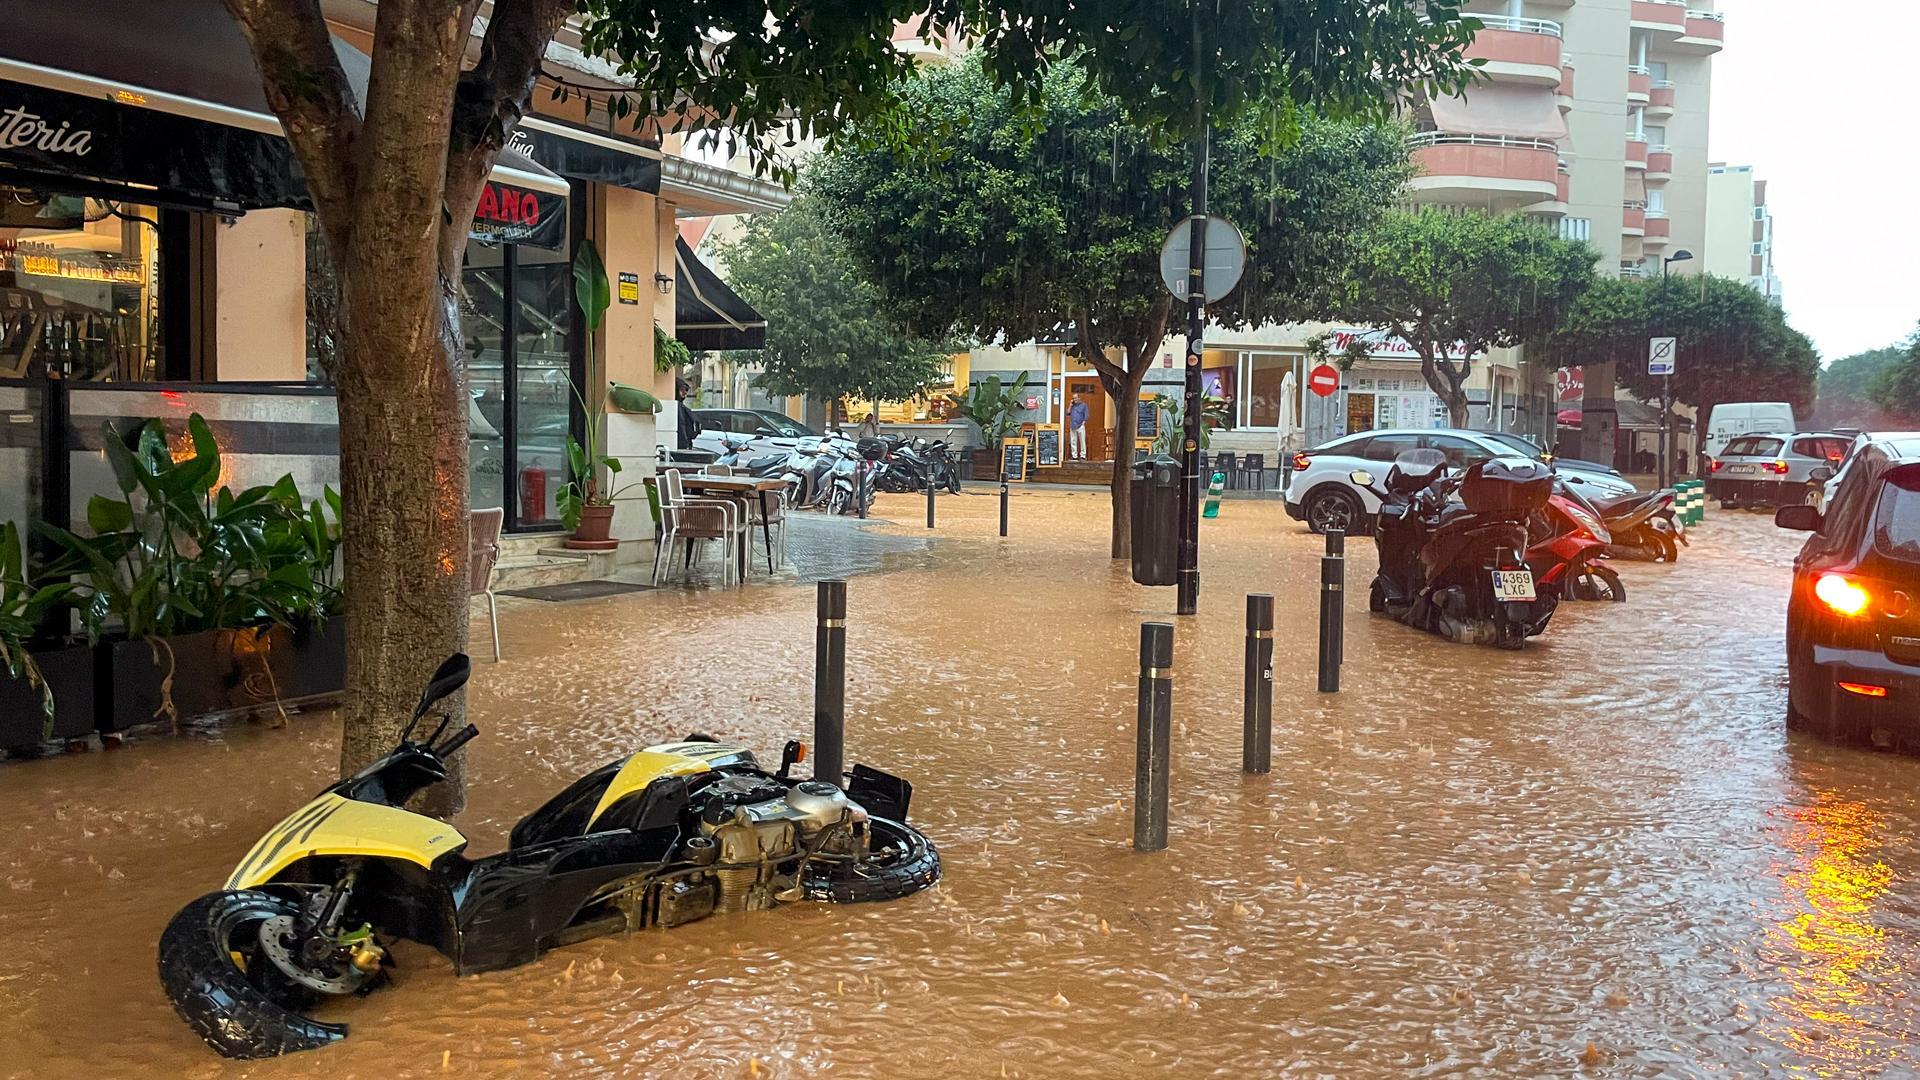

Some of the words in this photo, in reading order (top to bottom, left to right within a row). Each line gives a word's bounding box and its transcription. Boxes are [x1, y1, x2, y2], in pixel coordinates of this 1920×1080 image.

[0, 105, 92, 156] teria
[475, 183, 540, 226] ANO
[1502, 572, 1531, 584] 4369
[1503, 584, 1526, 596] LXG
